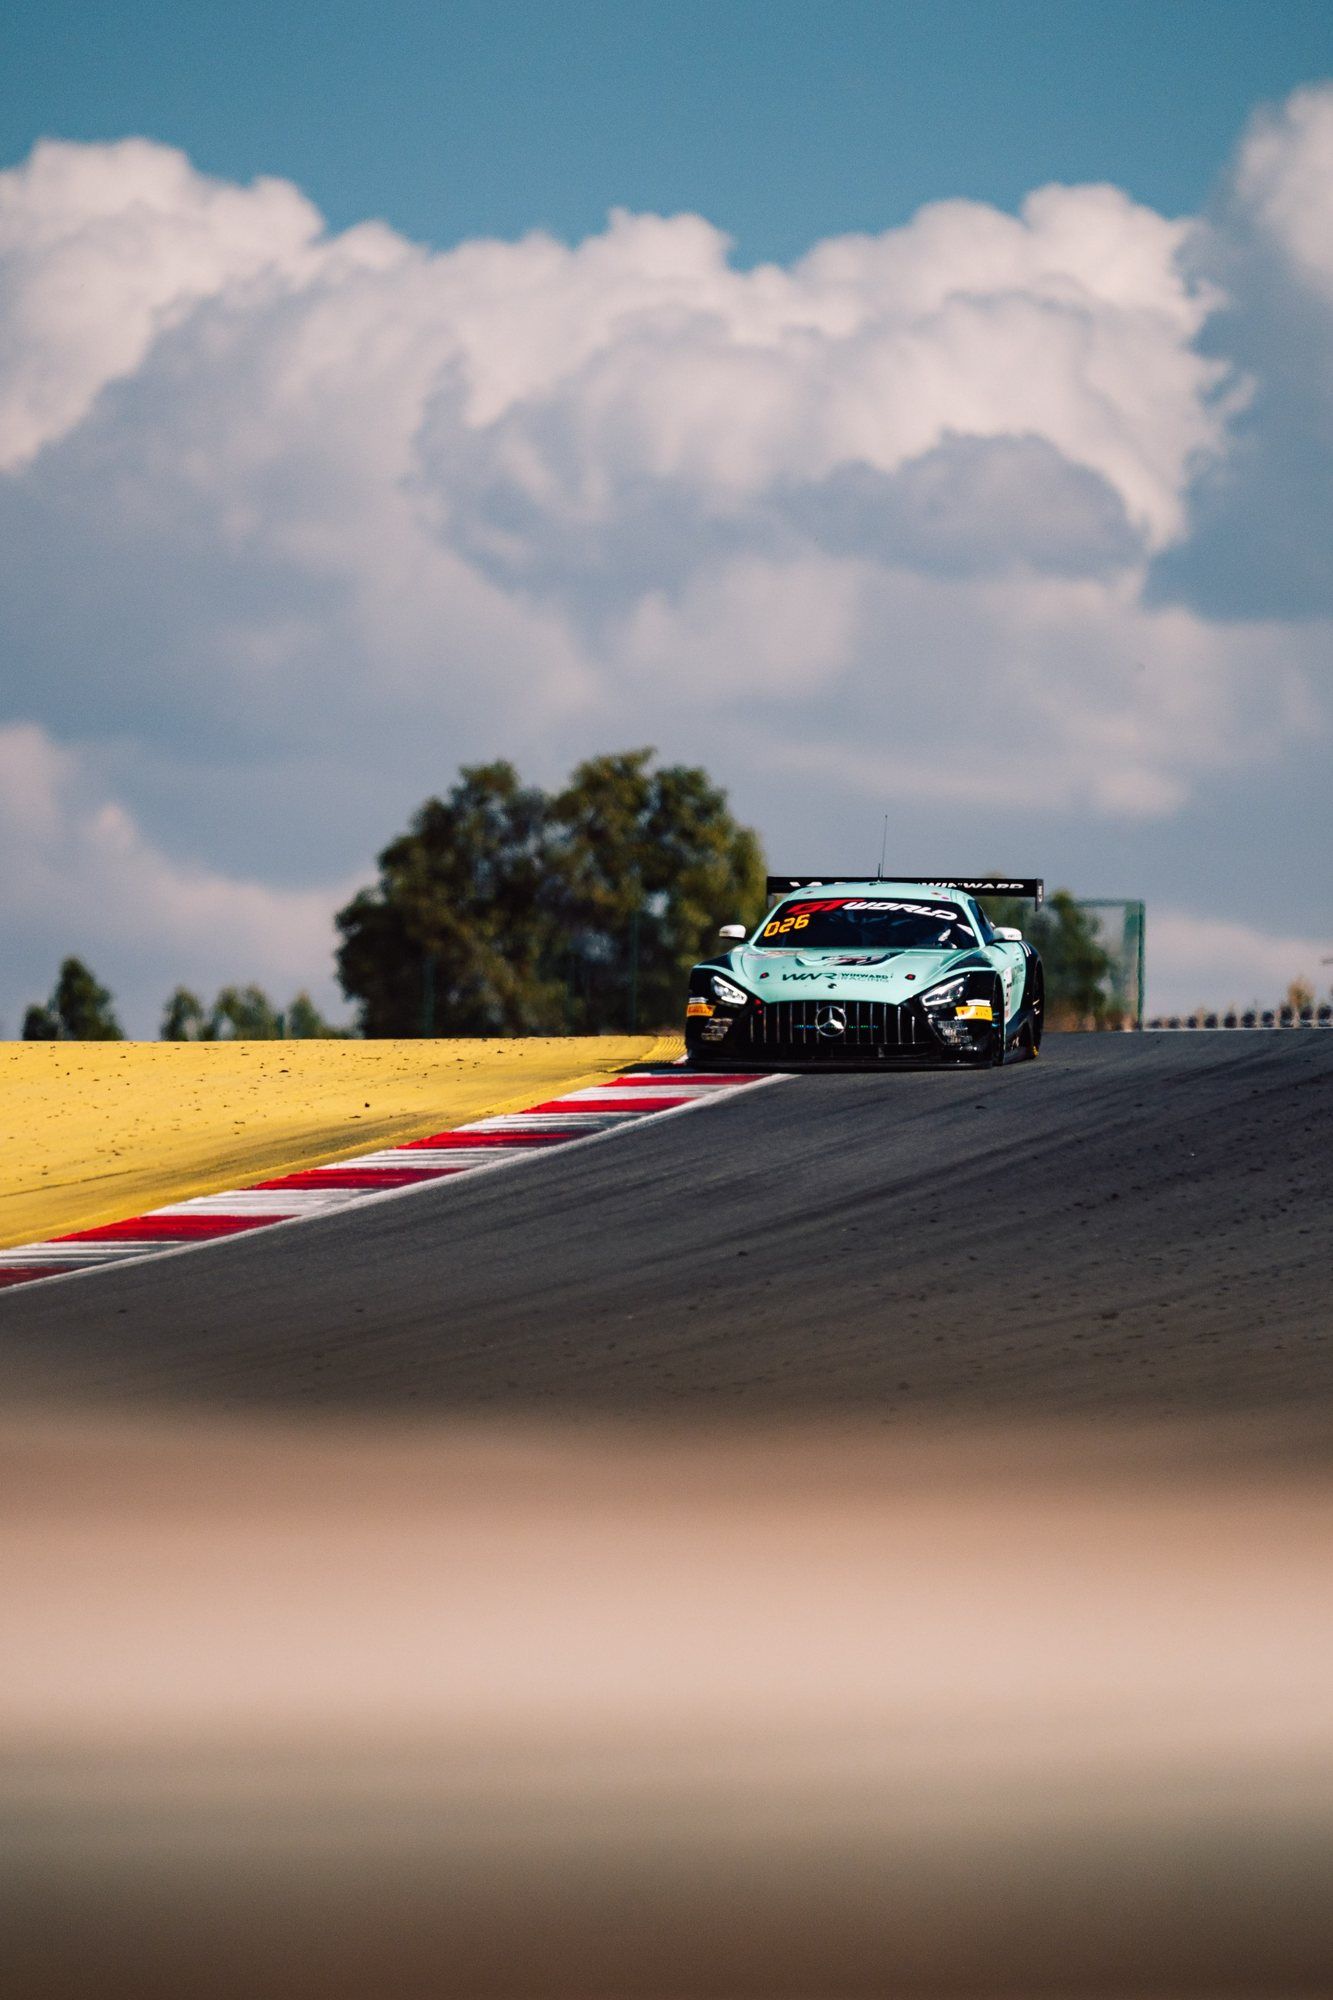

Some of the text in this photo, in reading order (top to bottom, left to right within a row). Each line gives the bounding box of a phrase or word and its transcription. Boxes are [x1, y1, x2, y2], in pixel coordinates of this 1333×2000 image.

[786, 898, 958, 920] GT WORLD
[763, 914, 810, 937] 026
